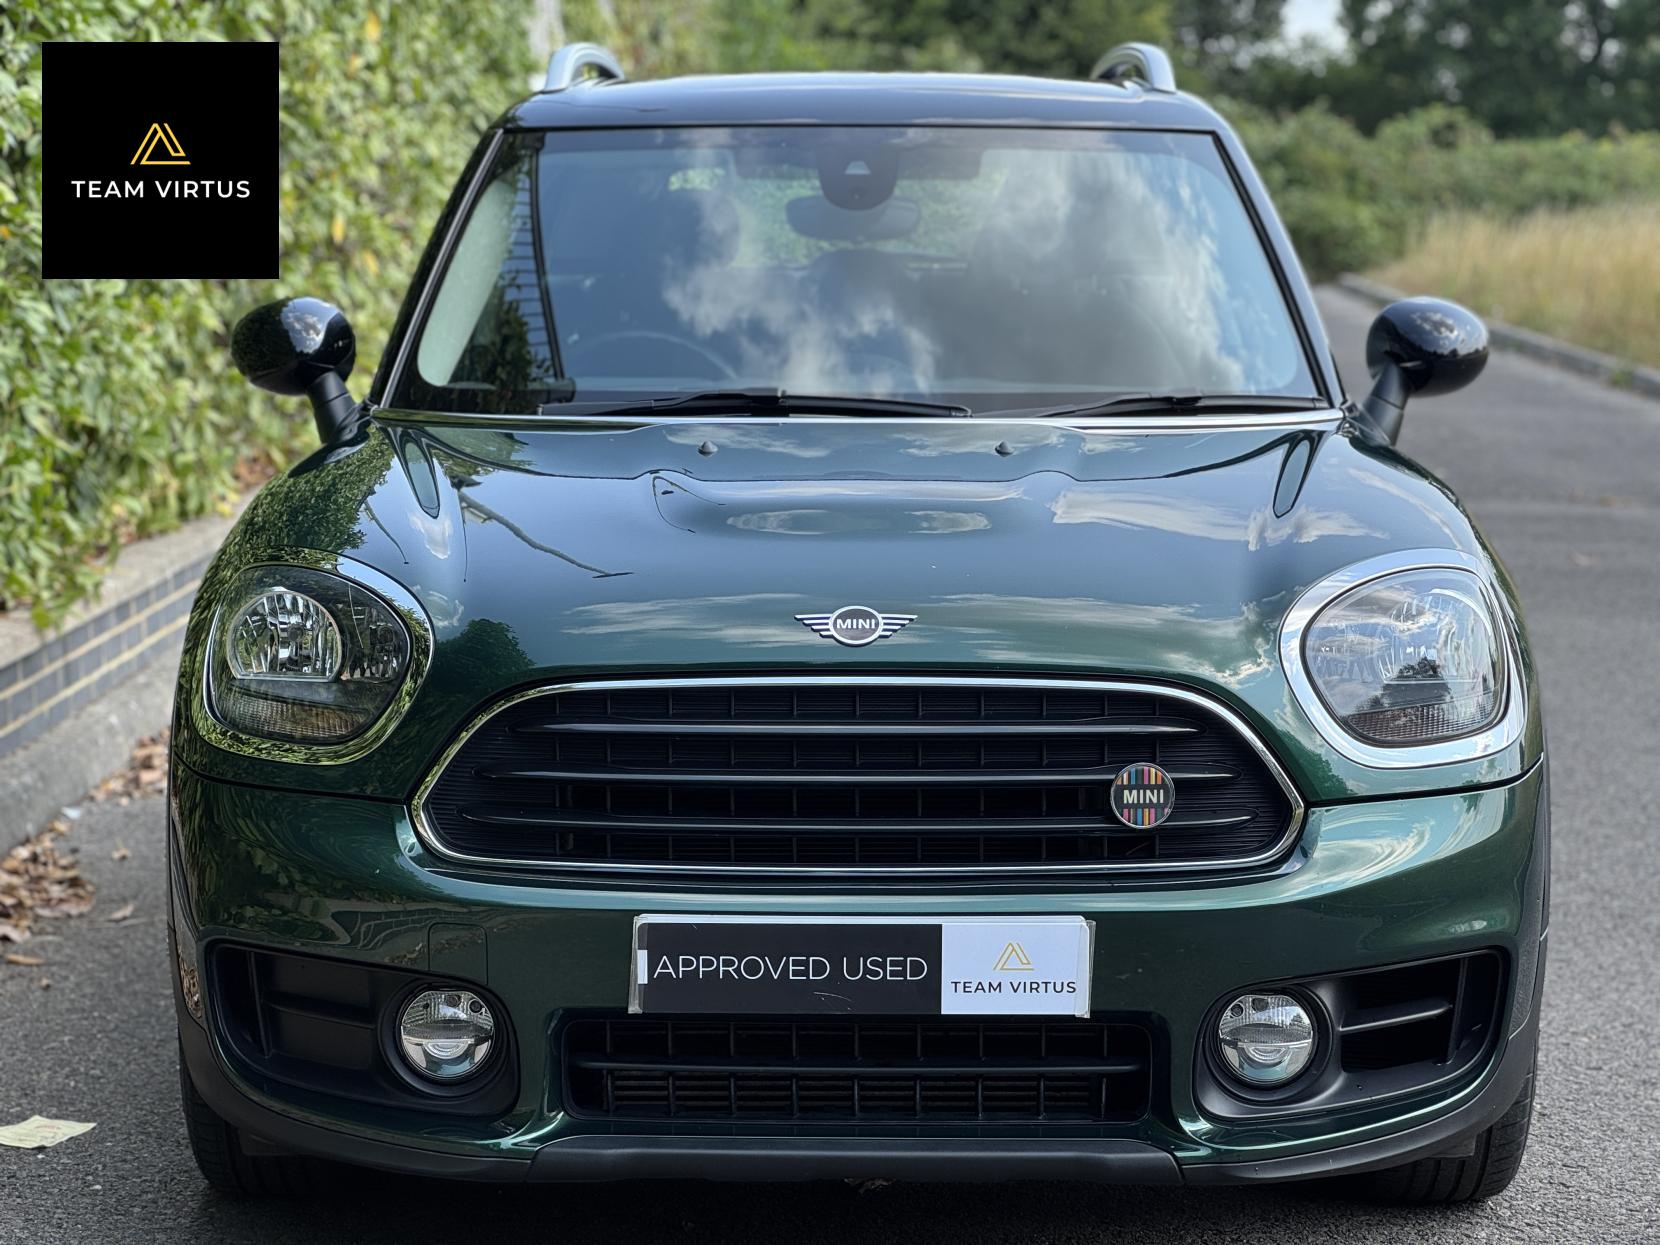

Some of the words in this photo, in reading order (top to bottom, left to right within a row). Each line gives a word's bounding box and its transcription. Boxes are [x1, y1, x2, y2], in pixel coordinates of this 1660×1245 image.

[836, 618, 876, 629] MINI
[1123, 789, 1164, 804] MINI
[653, 955, 831, 981] APPROVED
[842, 956, 928, 981] USED
[950, 980, 1003, 994] TEAM
[1009, 980, 1077, 994] VIRTUS
